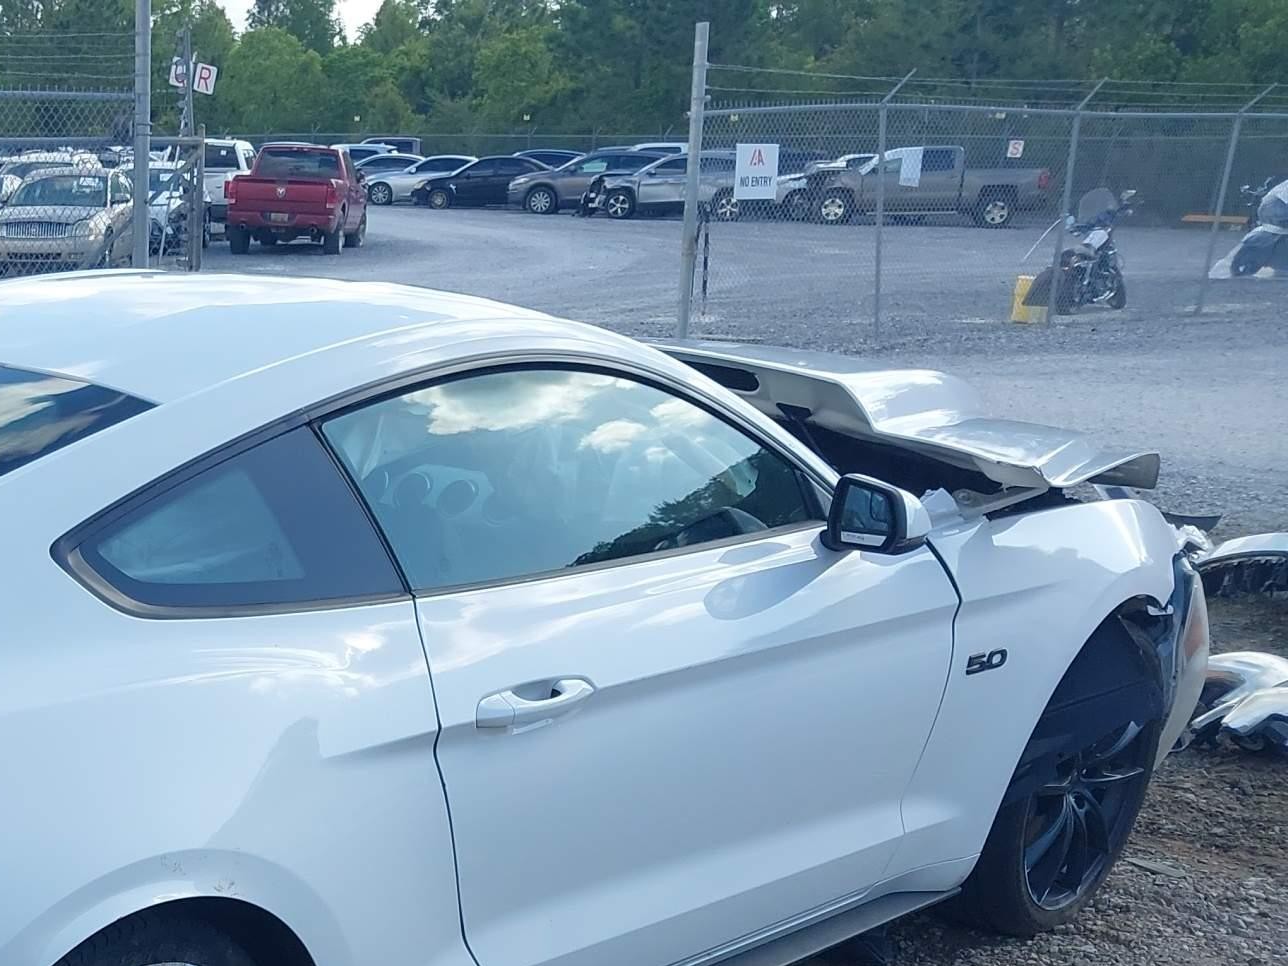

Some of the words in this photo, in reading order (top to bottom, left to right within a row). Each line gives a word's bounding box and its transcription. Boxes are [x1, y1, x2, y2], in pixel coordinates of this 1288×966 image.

[197, 66, 212, 92] R
[1010, 141, 1021, 156] S
[739, 175, 750, 188] NO
[751, 175, 773, 188] ENTRY
